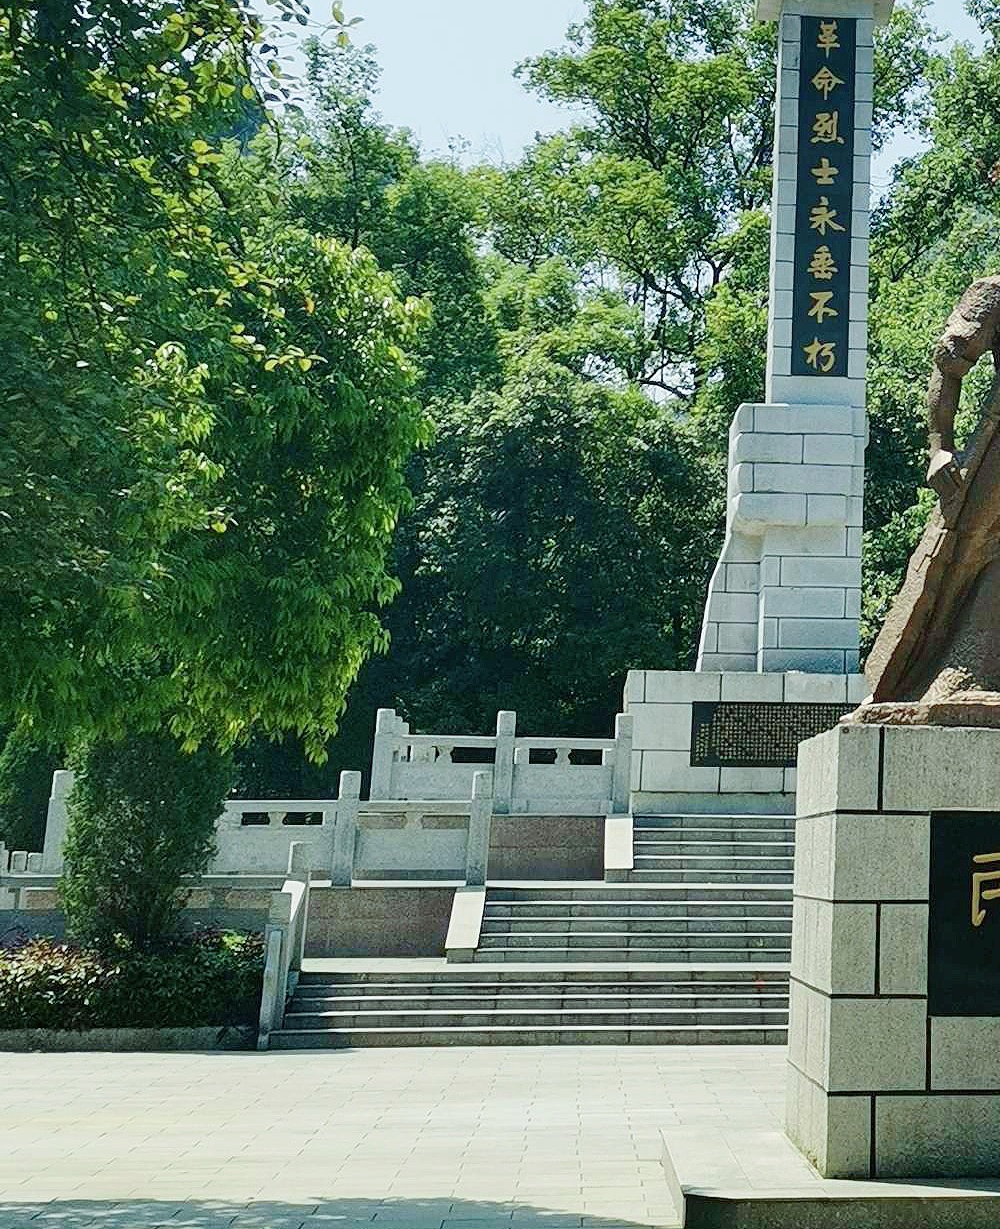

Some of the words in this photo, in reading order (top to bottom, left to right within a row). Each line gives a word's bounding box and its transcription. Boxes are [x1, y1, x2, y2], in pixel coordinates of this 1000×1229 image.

[802, 19, 846, 373] 革命烈士永垂不朽
